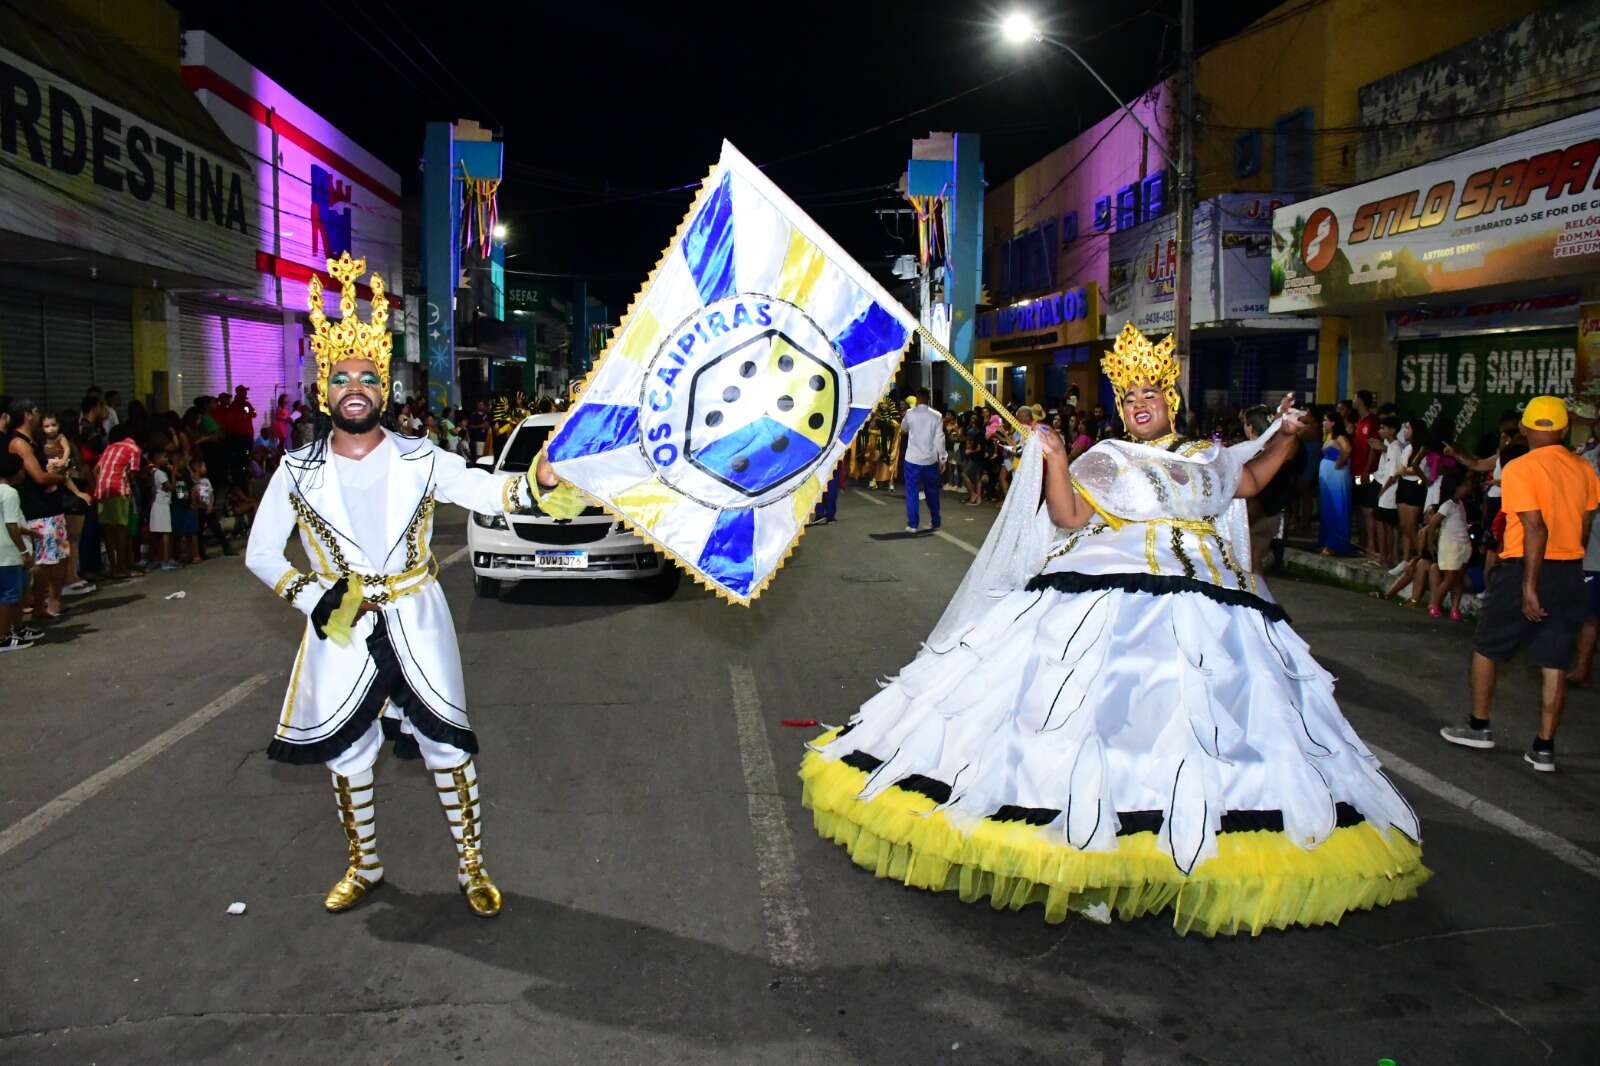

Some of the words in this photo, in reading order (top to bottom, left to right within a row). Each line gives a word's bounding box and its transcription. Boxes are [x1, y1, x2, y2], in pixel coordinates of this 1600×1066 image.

[0, 61, 248, 235] RDESTINA
[1347, 179, 1455, 246] STILO
[1473, 218, 1513, 234] BARATO
[1514, 212, 1528, 225] SÓ
[1530, 212, 1544, 222] SE
[1546, 207, 1569, 218] FOR
[1571, 203, 1588, 213] DE
[509, 288, 539, 303] SEFAZ
[649, 302, 773, 412] CAIPIRAS
[1401, 352, 1476, 395] STILO
[648, 422, 678, 467] OS
